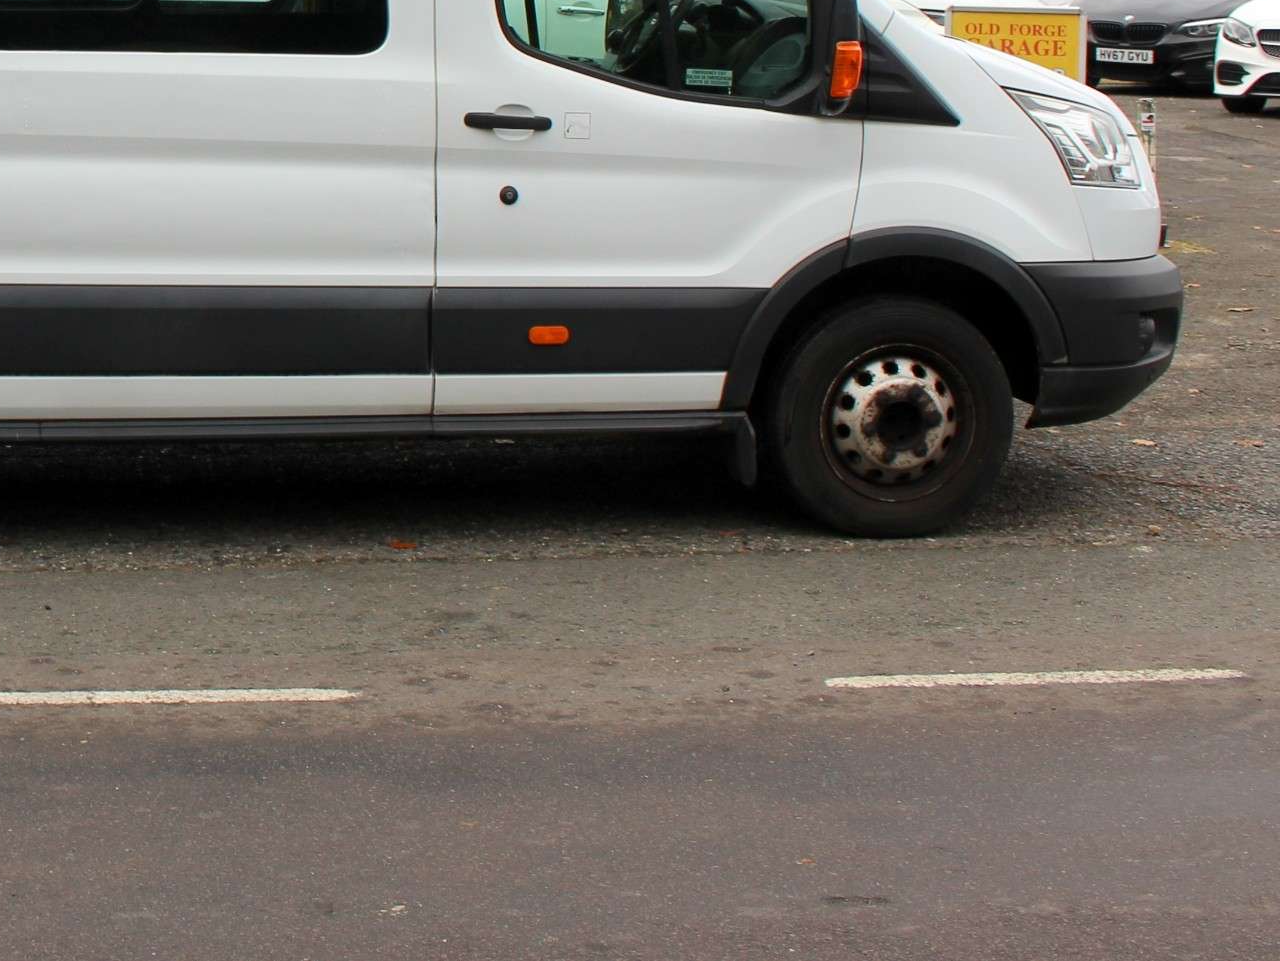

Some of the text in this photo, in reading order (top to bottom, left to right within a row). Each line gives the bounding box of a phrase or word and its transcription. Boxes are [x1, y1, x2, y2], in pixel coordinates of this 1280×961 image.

[965, 23, 1067, 37] OLD FORGE
[1099, 50, 1149, 62] HV67 GYU
